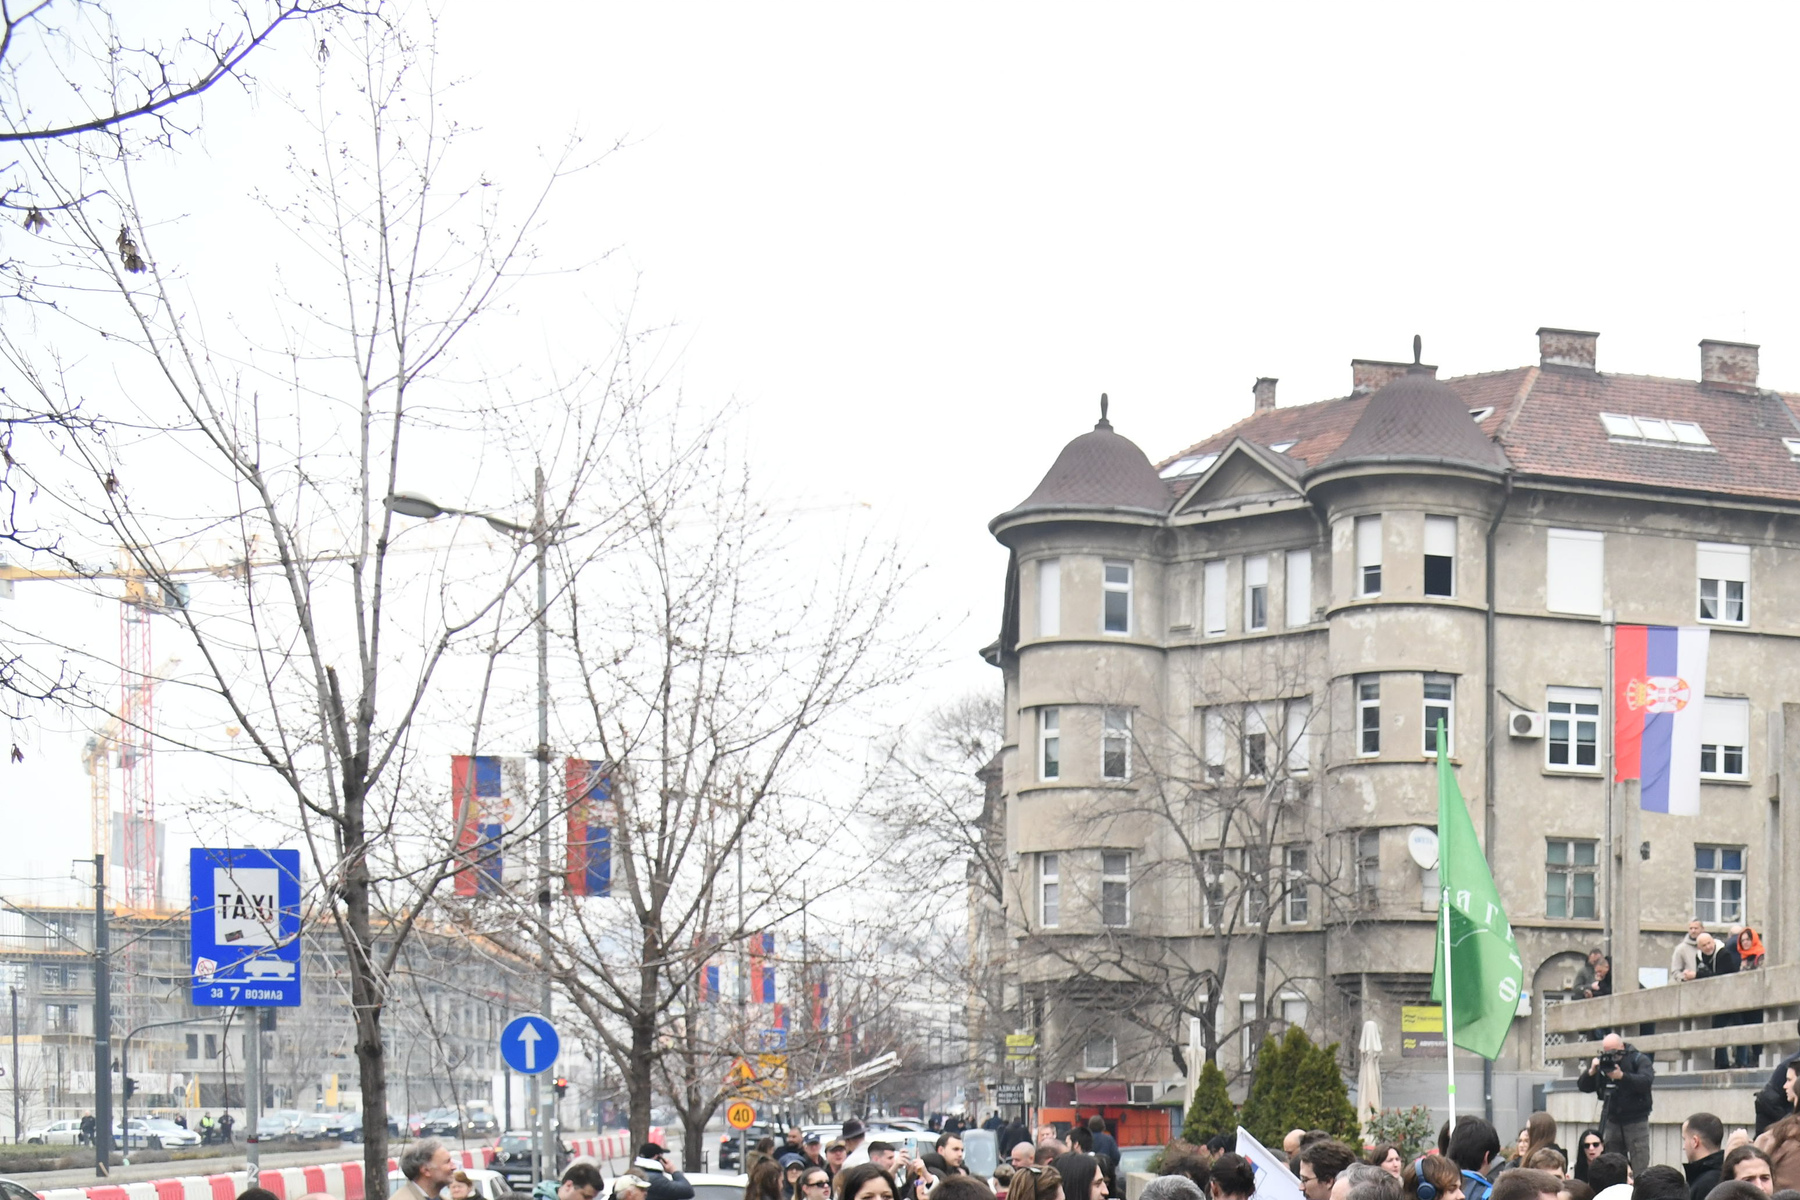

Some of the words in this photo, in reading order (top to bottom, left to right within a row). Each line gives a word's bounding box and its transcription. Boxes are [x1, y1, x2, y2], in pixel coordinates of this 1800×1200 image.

[218, 894, 273, 920] TAXI
[210, 988, 223, 999] за
[230, 986, 240, 1000] 7
[245, 988, 283, 1001] возила
[733, 1108, 750, 1123] 40
